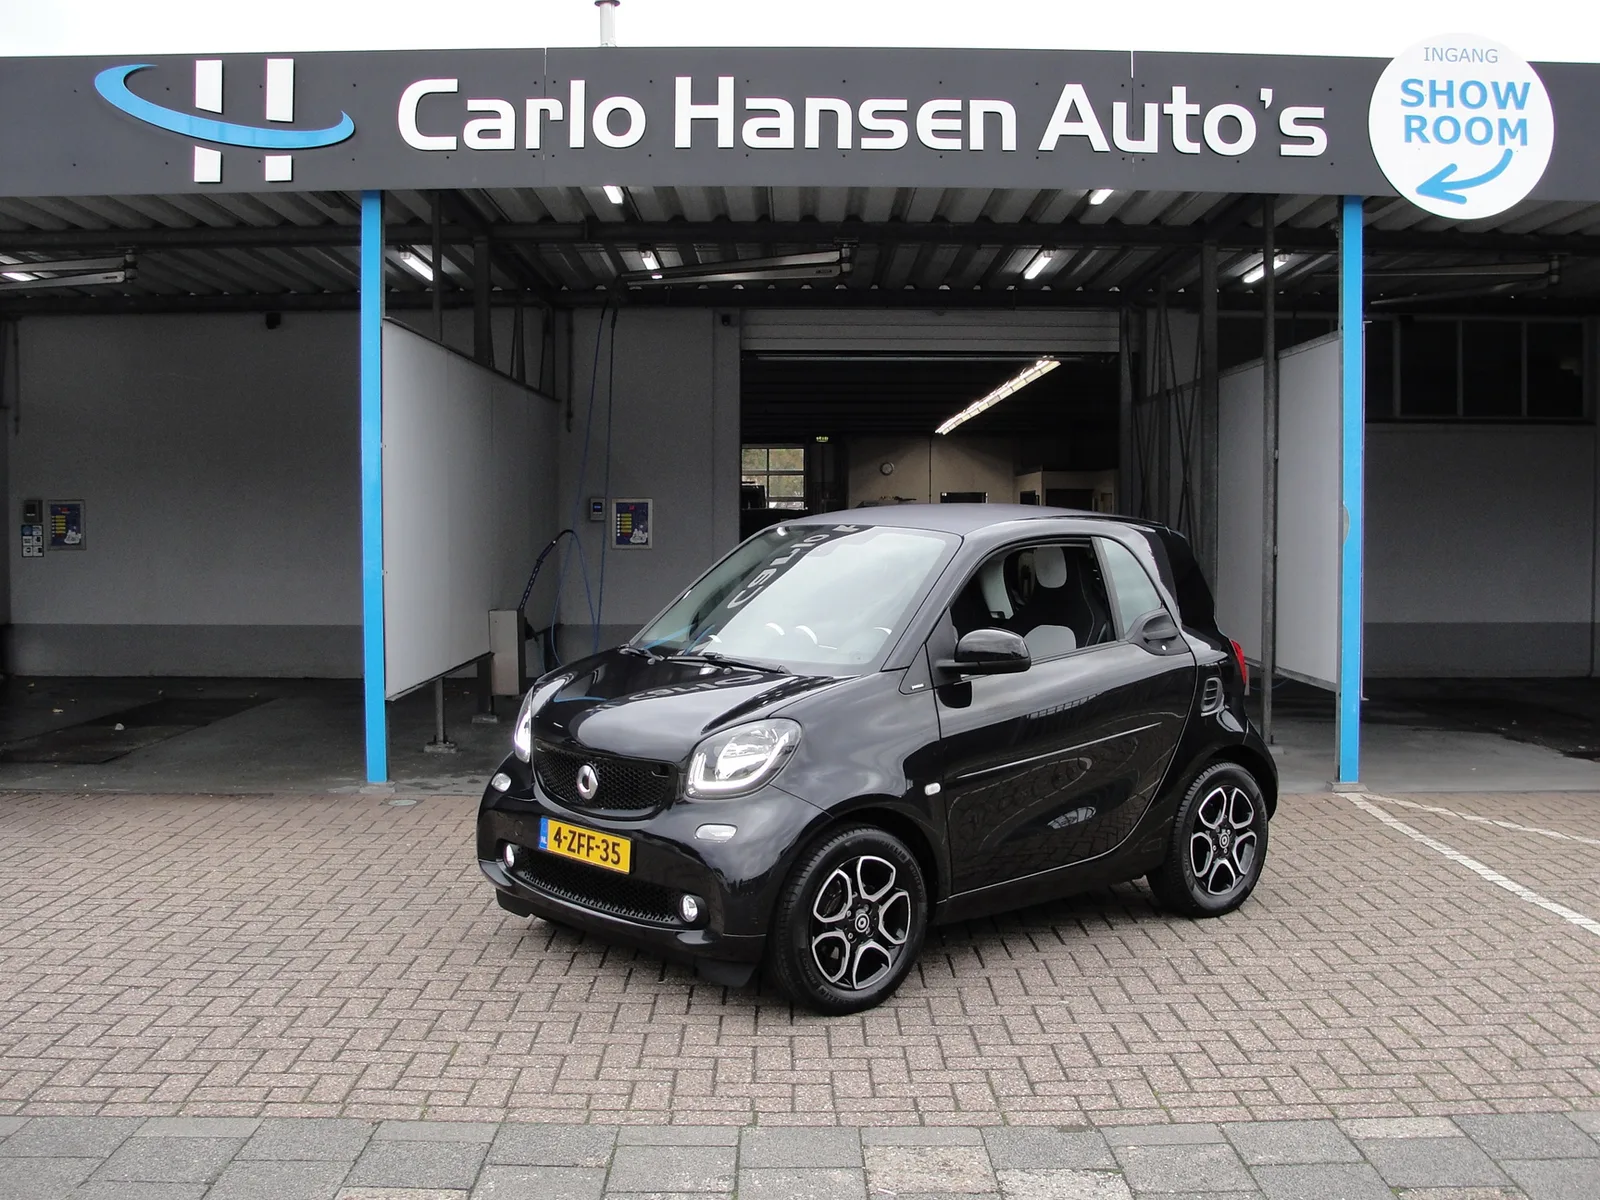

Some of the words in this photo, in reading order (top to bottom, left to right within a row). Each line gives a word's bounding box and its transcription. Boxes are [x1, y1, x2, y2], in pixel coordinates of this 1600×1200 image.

[1423, 47, 1498, 64] INGANG
[1400, 78, 1532, 111] SHOW
[397, 78, 646, 151] Carlo
[674, 75, 1018, 151] Hansen
[1038, 83, 1328, 157] Auto's
[1403, 114, 1528, 147] ROOM
[553, 826, 621, 866] 4-ZFF-35
